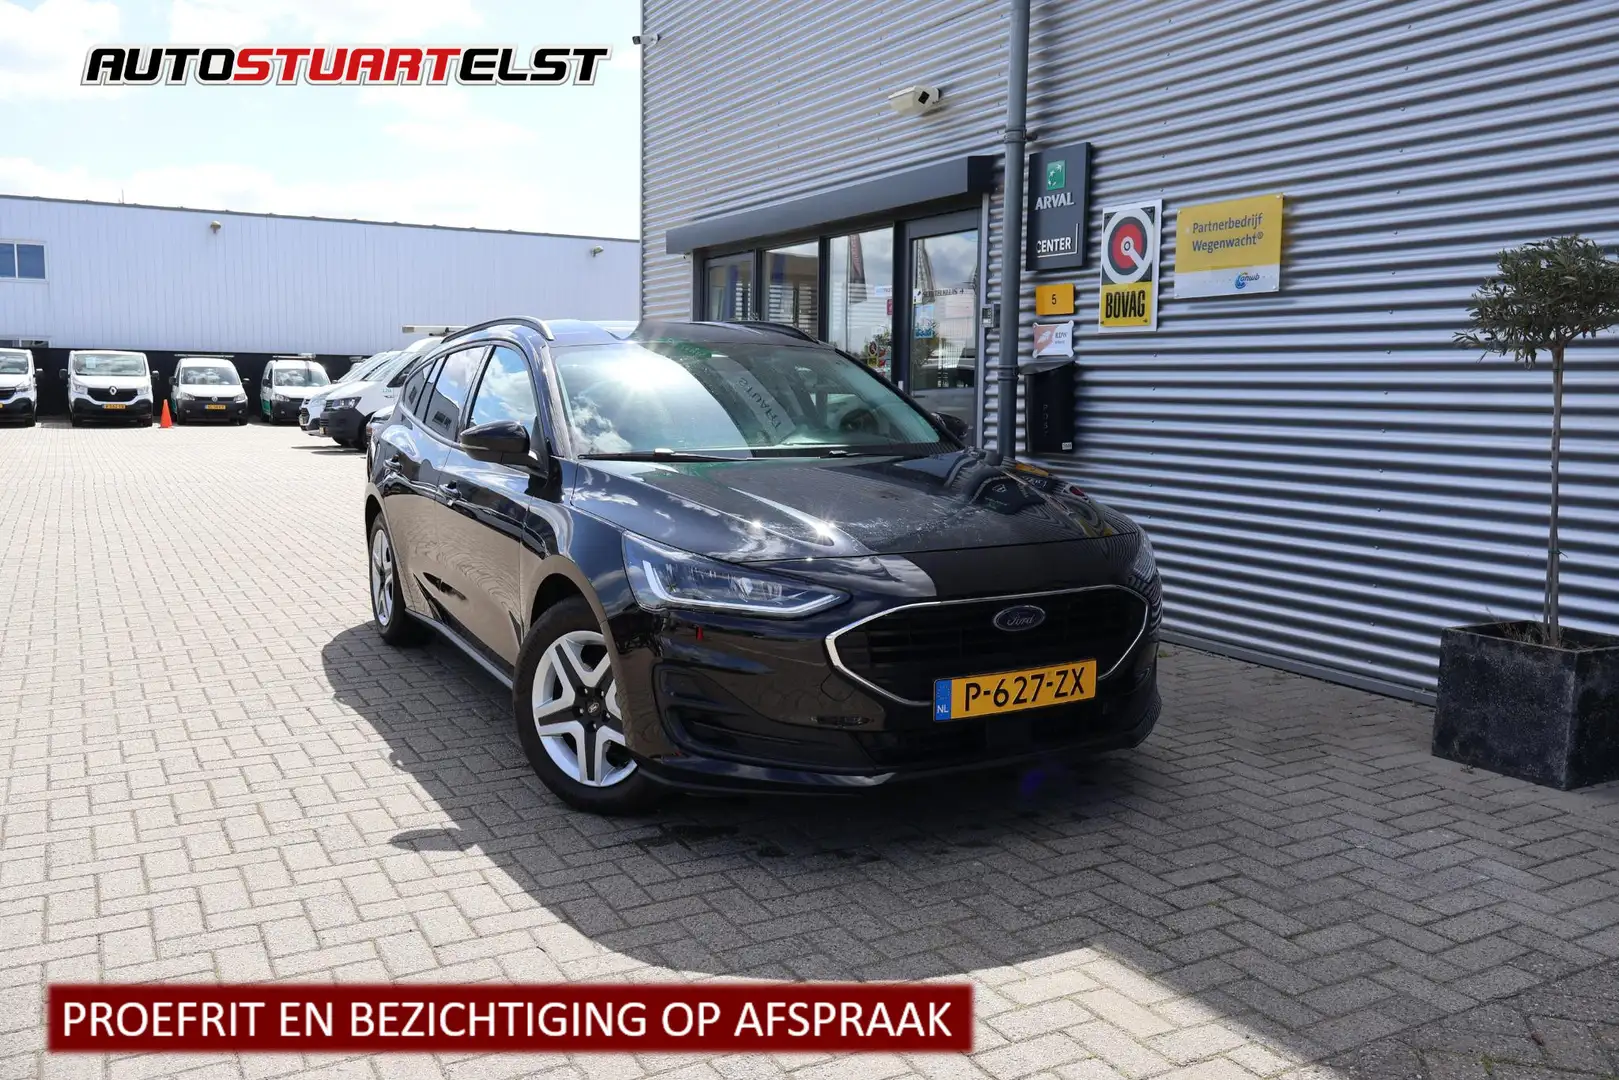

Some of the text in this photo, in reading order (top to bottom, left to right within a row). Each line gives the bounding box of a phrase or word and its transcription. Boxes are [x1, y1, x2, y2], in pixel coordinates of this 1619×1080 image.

[1035, 192, 1074, 211] ARVAL
[1192, 213, 1263, 234] Partnerbedrijf
[1036, 236, 1072, 253] CENTER
[1051, 294, 1057, 305] 5
[1105, 290, 1146, 319] BOVAG
[1006, 613, 1035, 626] Ford
[964, 667, 1085, 712] P-627-ZX
[937, 704, 949, 714] NL
